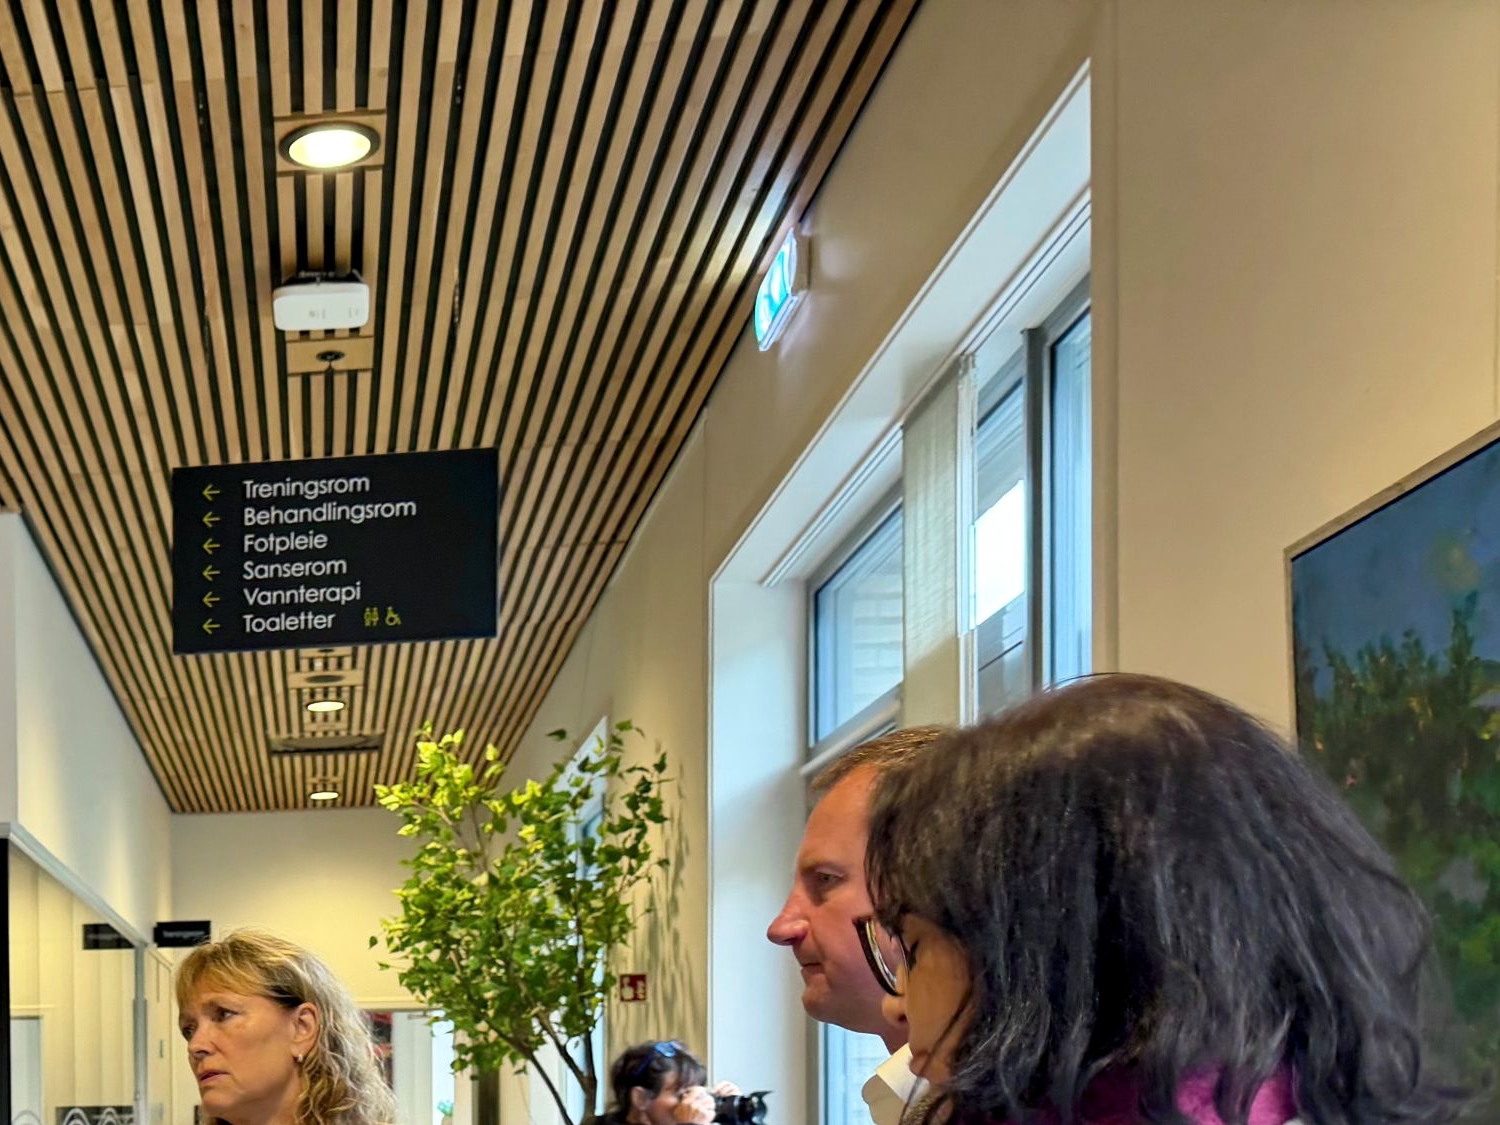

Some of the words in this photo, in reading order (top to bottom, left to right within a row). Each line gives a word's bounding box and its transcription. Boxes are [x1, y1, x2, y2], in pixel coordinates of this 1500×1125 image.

[243, 477, 371, 500] Treningsrom
[243, 501, 417, 526] Behandlingsrom
[243, 531, 329, 555] Fotpleie
[243, 559, 348, 580] Sanserom
[243, 581, 361, 606] Vannterapi
[243, 611, 336, 633] Toaletter
